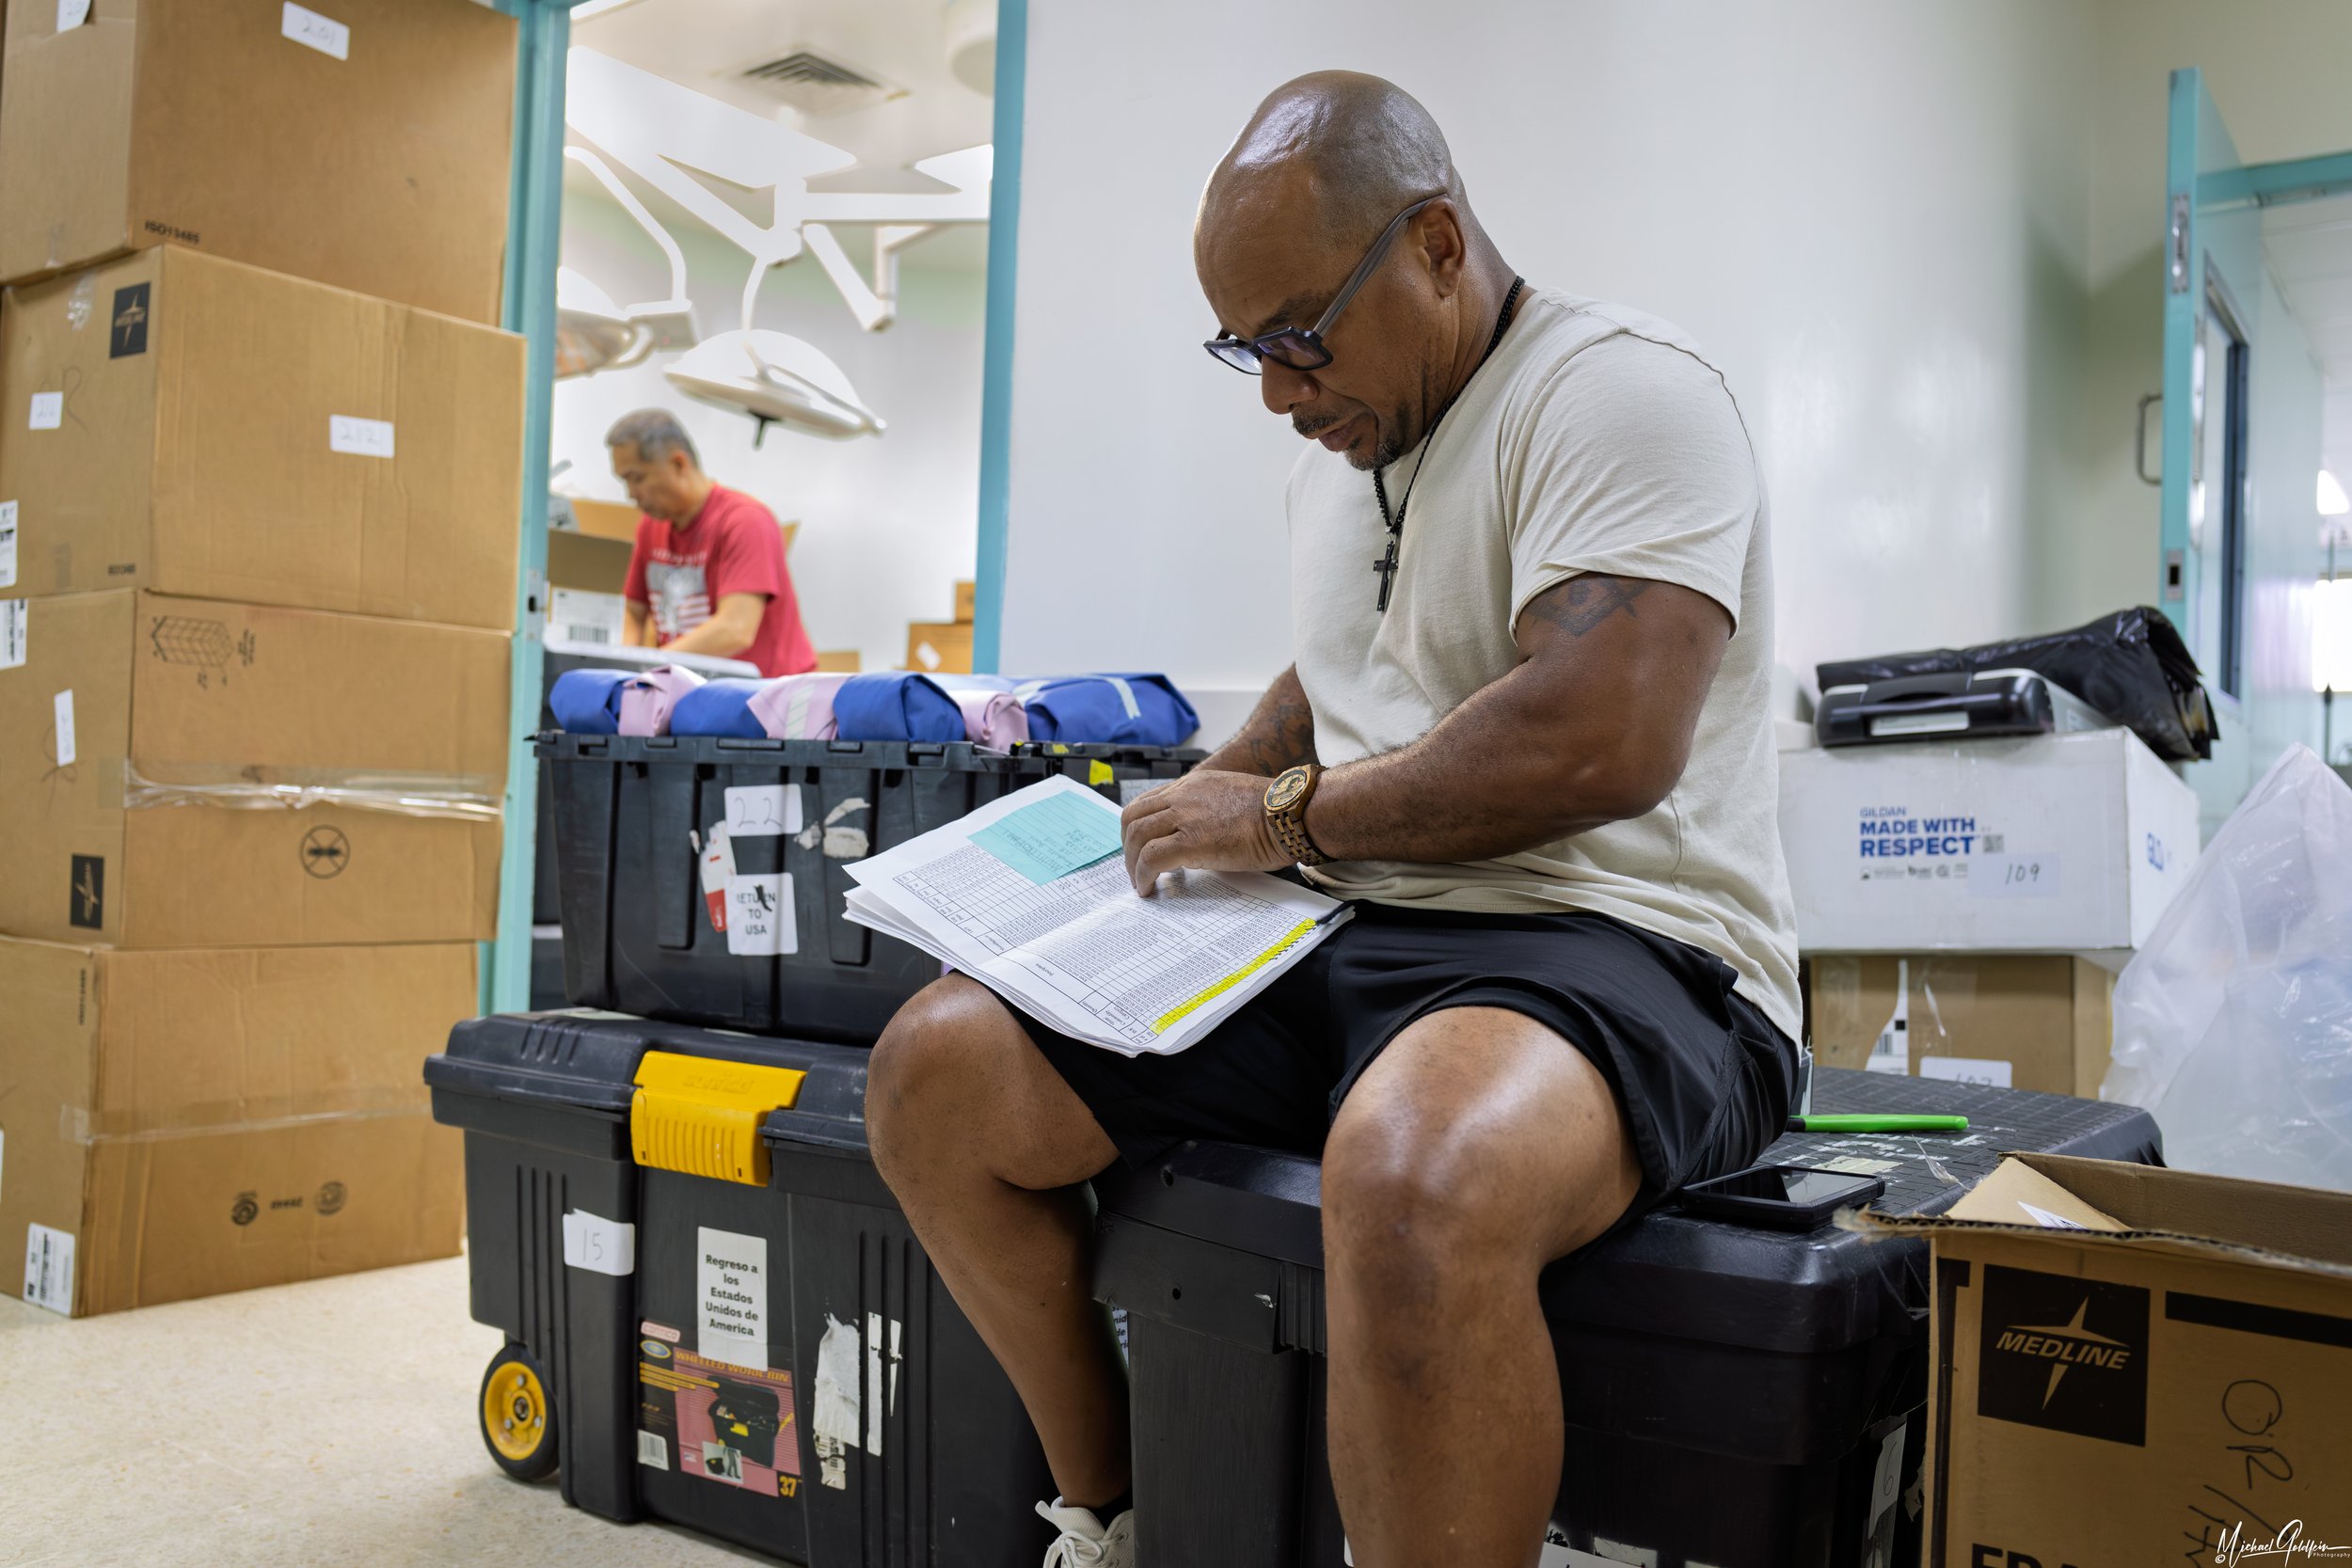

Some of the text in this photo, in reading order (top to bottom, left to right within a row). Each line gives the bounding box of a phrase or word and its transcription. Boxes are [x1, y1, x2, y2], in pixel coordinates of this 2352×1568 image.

[734, 797, 783, 829] 22
[1859, 806, 1906, 818] GILDAN
[1860, 817, 1976, 835] MADE WITH
[1860, 835, 1975, 858] RESPECT
[2006, 863, 2041, 885] 109
[748, 908, 762, 919] TO
[746, 924, 768, 935] USA
[582, 1228, 603, 1261] 15
[706, 1254, 758, 1274] Regreso a
[723, 1274, 739, 1286] los
[710, 1287, 753, 1304] Estados
[706, 1301, 758, 1321] Unidos de
[709, 1319, 755, 1337] America
[1995, 1331, 2131, 1370] MEDLINE
[767, 1370, 789, 1385] BIN
